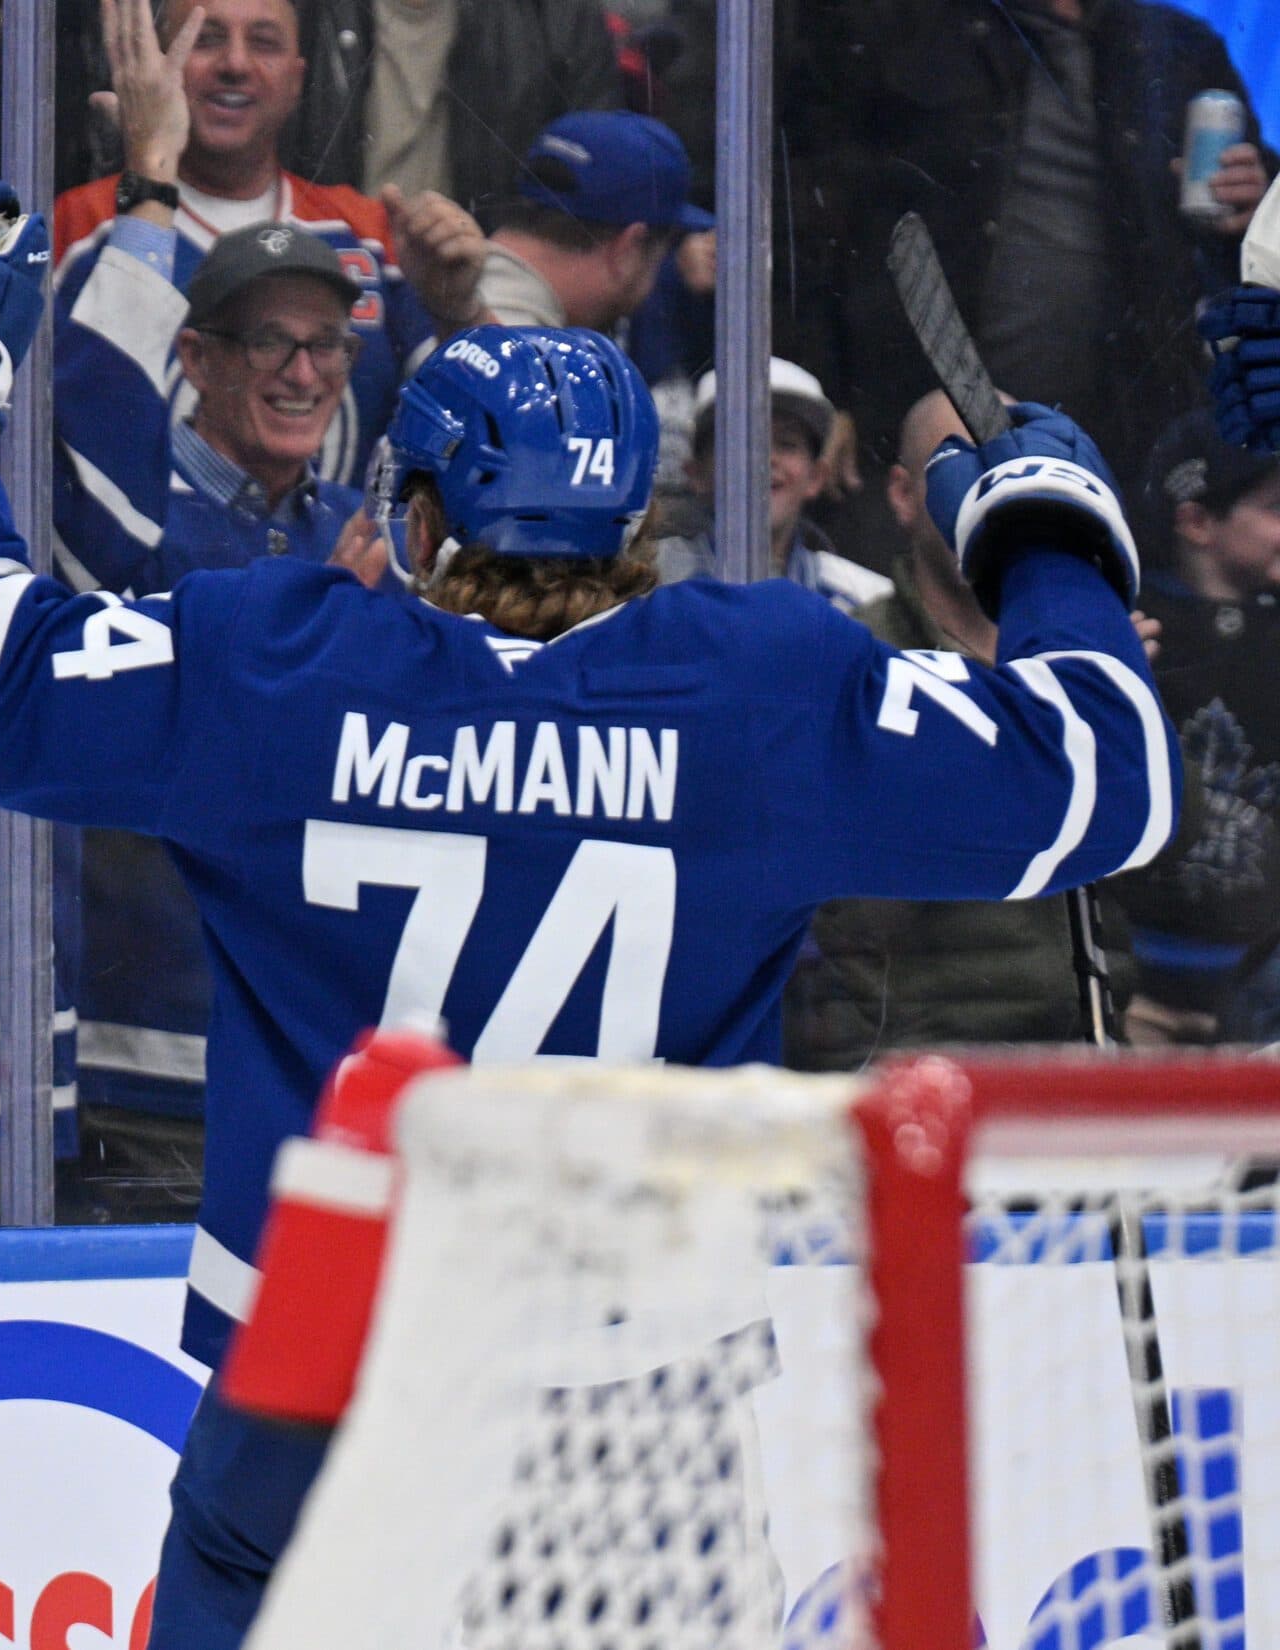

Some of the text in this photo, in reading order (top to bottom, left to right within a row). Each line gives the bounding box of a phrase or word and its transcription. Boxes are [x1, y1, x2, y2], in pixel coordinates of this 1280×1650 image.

[443, 339, 501, 379] OREO
[567, 437, 615, 486] 74
[331, 711, 679, 822] McMANN
[302, 818, 678, 1068] 74
